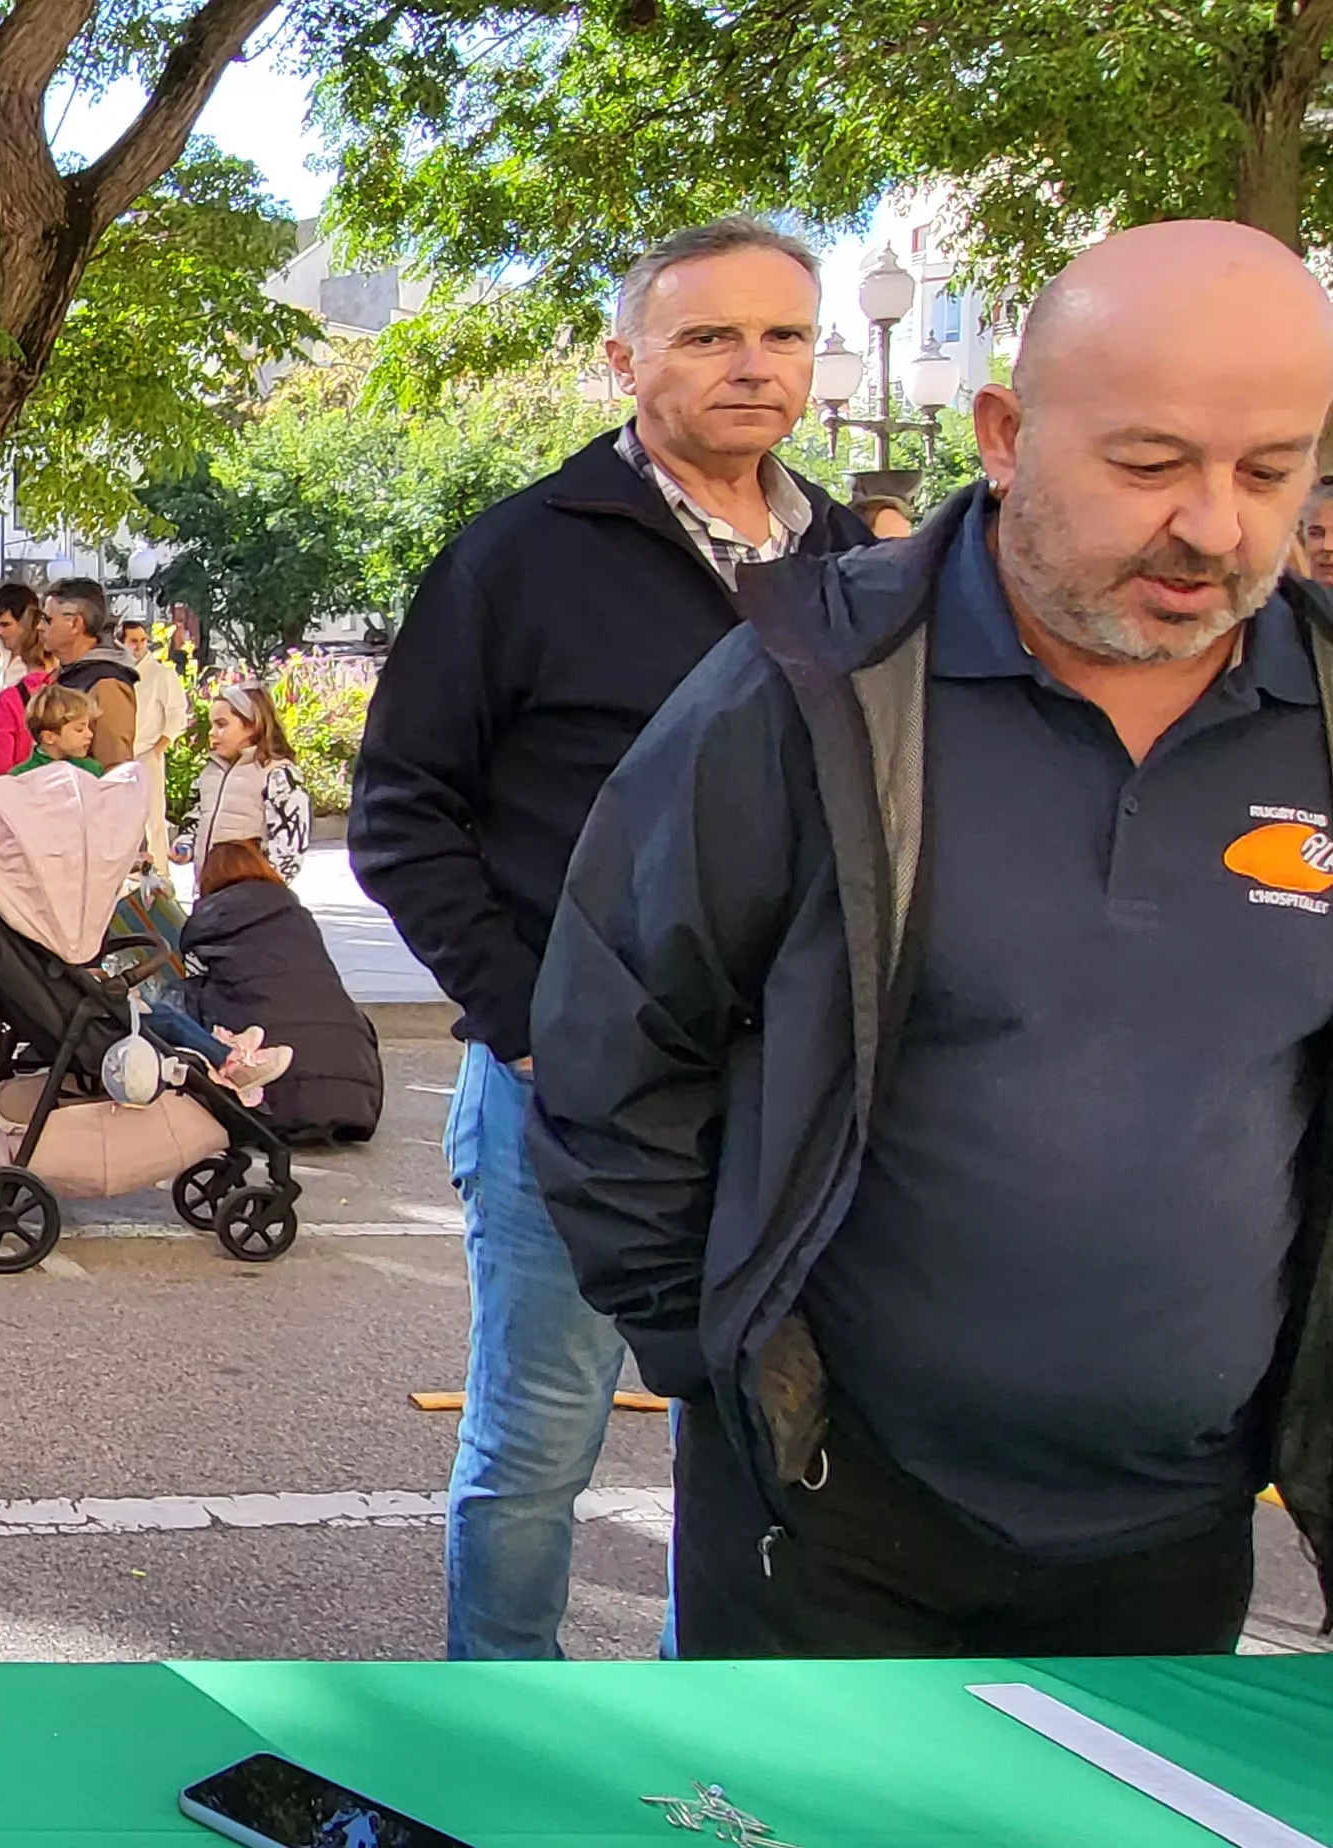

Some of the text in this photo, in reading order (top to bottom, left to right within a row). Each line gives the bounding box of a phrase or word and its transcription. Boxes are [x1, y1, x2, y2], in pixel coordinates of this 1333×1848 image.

[1249, 804, 1329, 827] RUGBY CLUB
[1248, 889, 1330, 915] L'HOSPITALET
